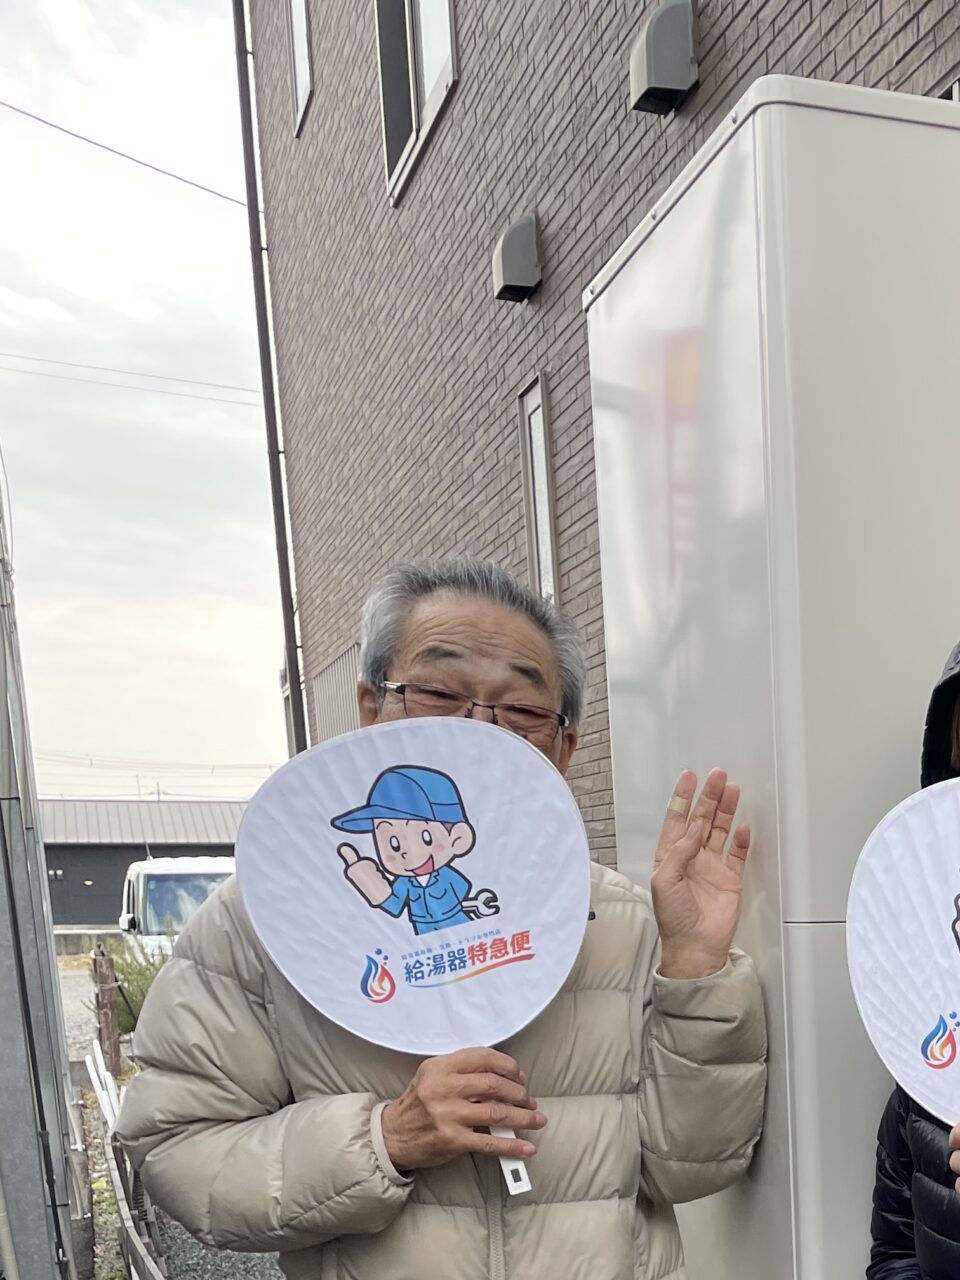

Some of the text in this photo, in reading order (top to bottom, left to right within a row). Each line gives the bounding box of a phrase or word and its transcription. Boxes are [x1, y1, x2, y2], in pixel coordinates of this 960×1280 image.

[404, 929, 533, 983] 給湯器特急便
